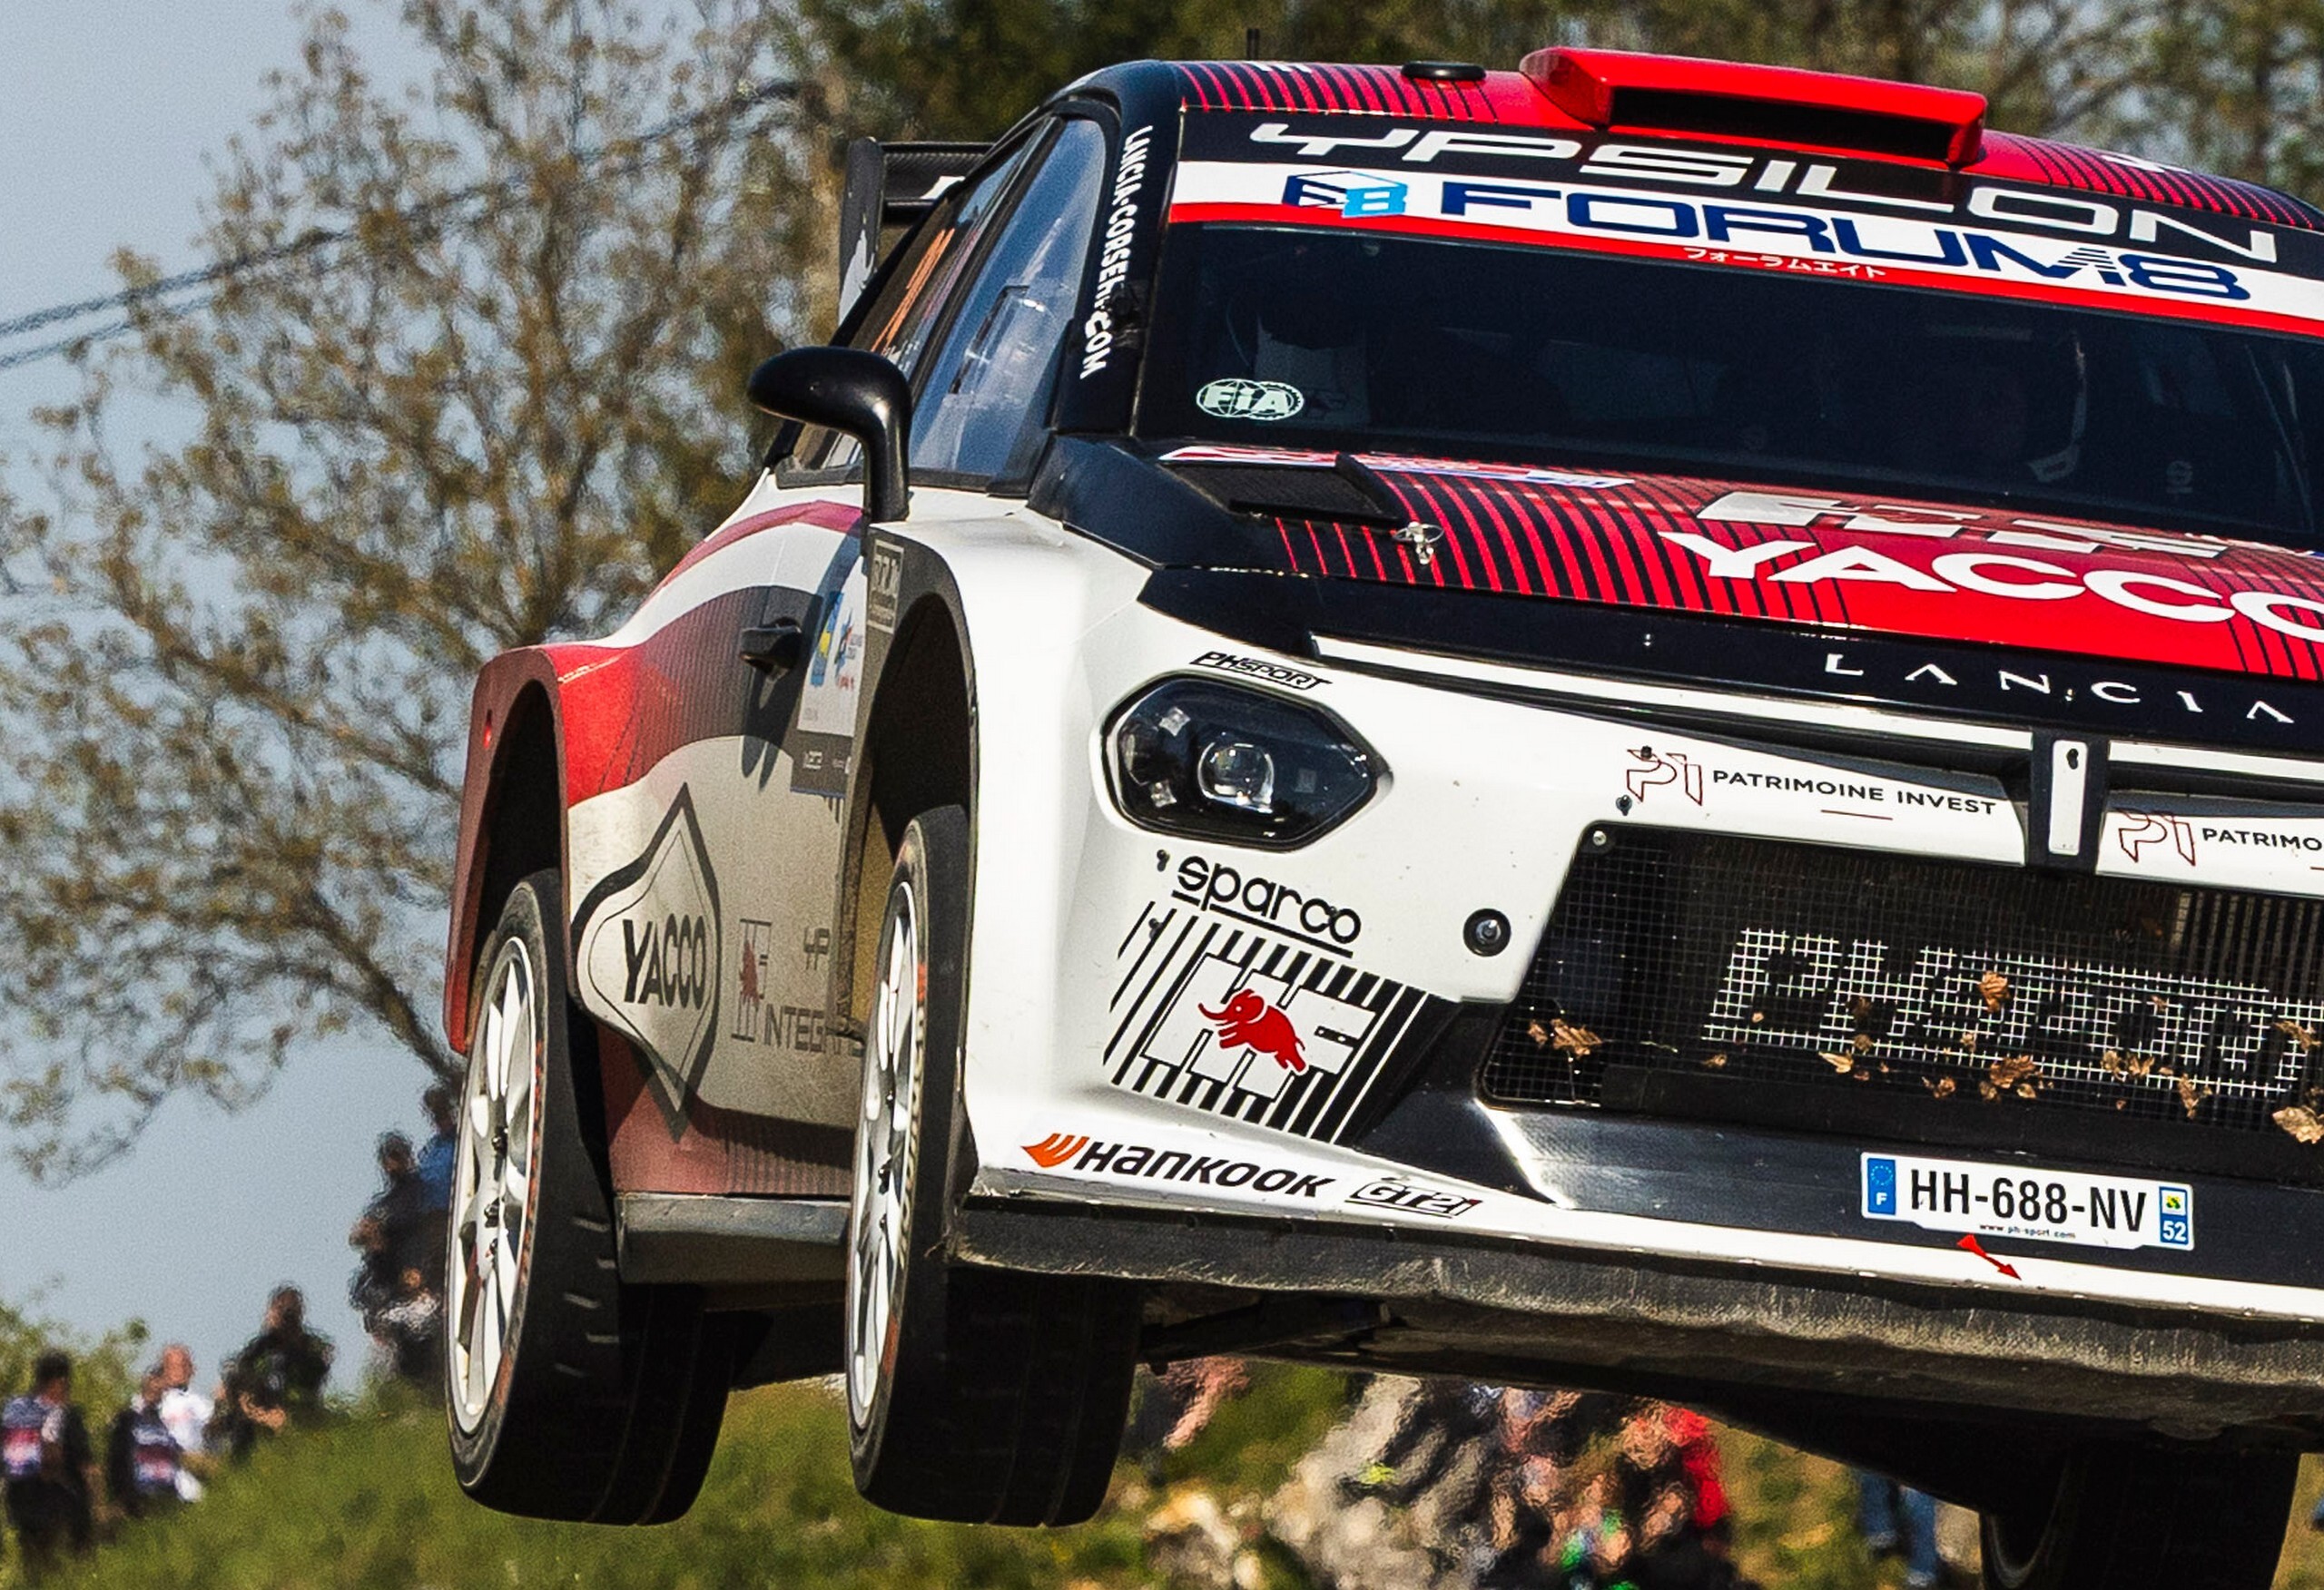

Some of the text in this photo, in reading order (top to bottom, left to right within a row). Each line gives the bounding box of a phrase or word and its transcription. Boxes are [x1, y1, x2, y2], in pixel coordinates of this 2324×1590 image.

[1250, 123, 2277, 263] YPSILON
[1441, 182, 2251, 301] FORUM8
[1825, 653, 2294, 724] LANCIA
[1713, 770, 1885, 802] PATRIMOINE
[1897, 790, 1997, 815] INVEST
[1177, 856, 1362, 945] sparco
[622, 913, 706, 1010] YACCO
[1876, 1192, 1888, 1206] F
[1910, 1168, 2147, 1232] HH-688-NV
[2162, 1220, 2188, 1242] 52
